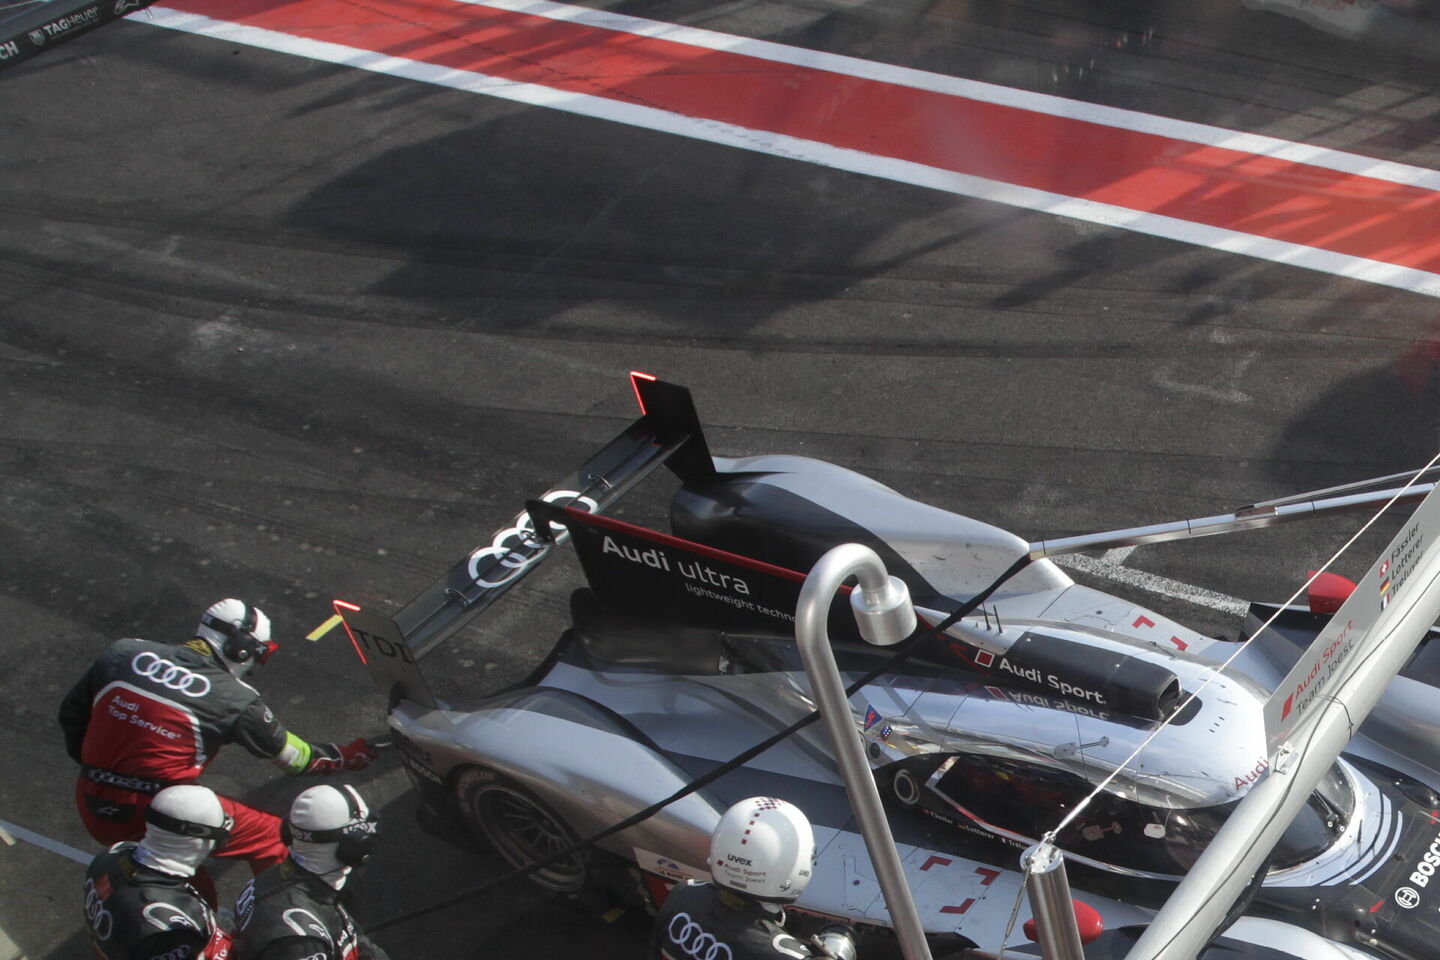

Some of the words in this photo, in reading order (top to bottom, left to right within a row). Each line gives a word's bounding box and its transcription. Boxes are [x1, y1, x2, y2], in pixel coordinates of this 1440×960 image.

[602, 535, 671, 572] Audi
[677, 561, 750, 594] ultra
[685, 583, 755, 612] lightweight
[351, 627, 414, 665] TDI
[1295, 659, 1321, 699] Audi
[1322, 620, 1353, 663] Sport
[999, 657, 1042, 684] Audi
[1047, 674, 1105, 704] Sport
[1295, 676, 1326, 716] Team
[111, 695, 140, 712] Audi
[107, 705, 127, 721] Top
[129, 714, 179, 739] Service
[1234, 756, 1269, 791] Audi
[727, 853, 753, 867] uvex
